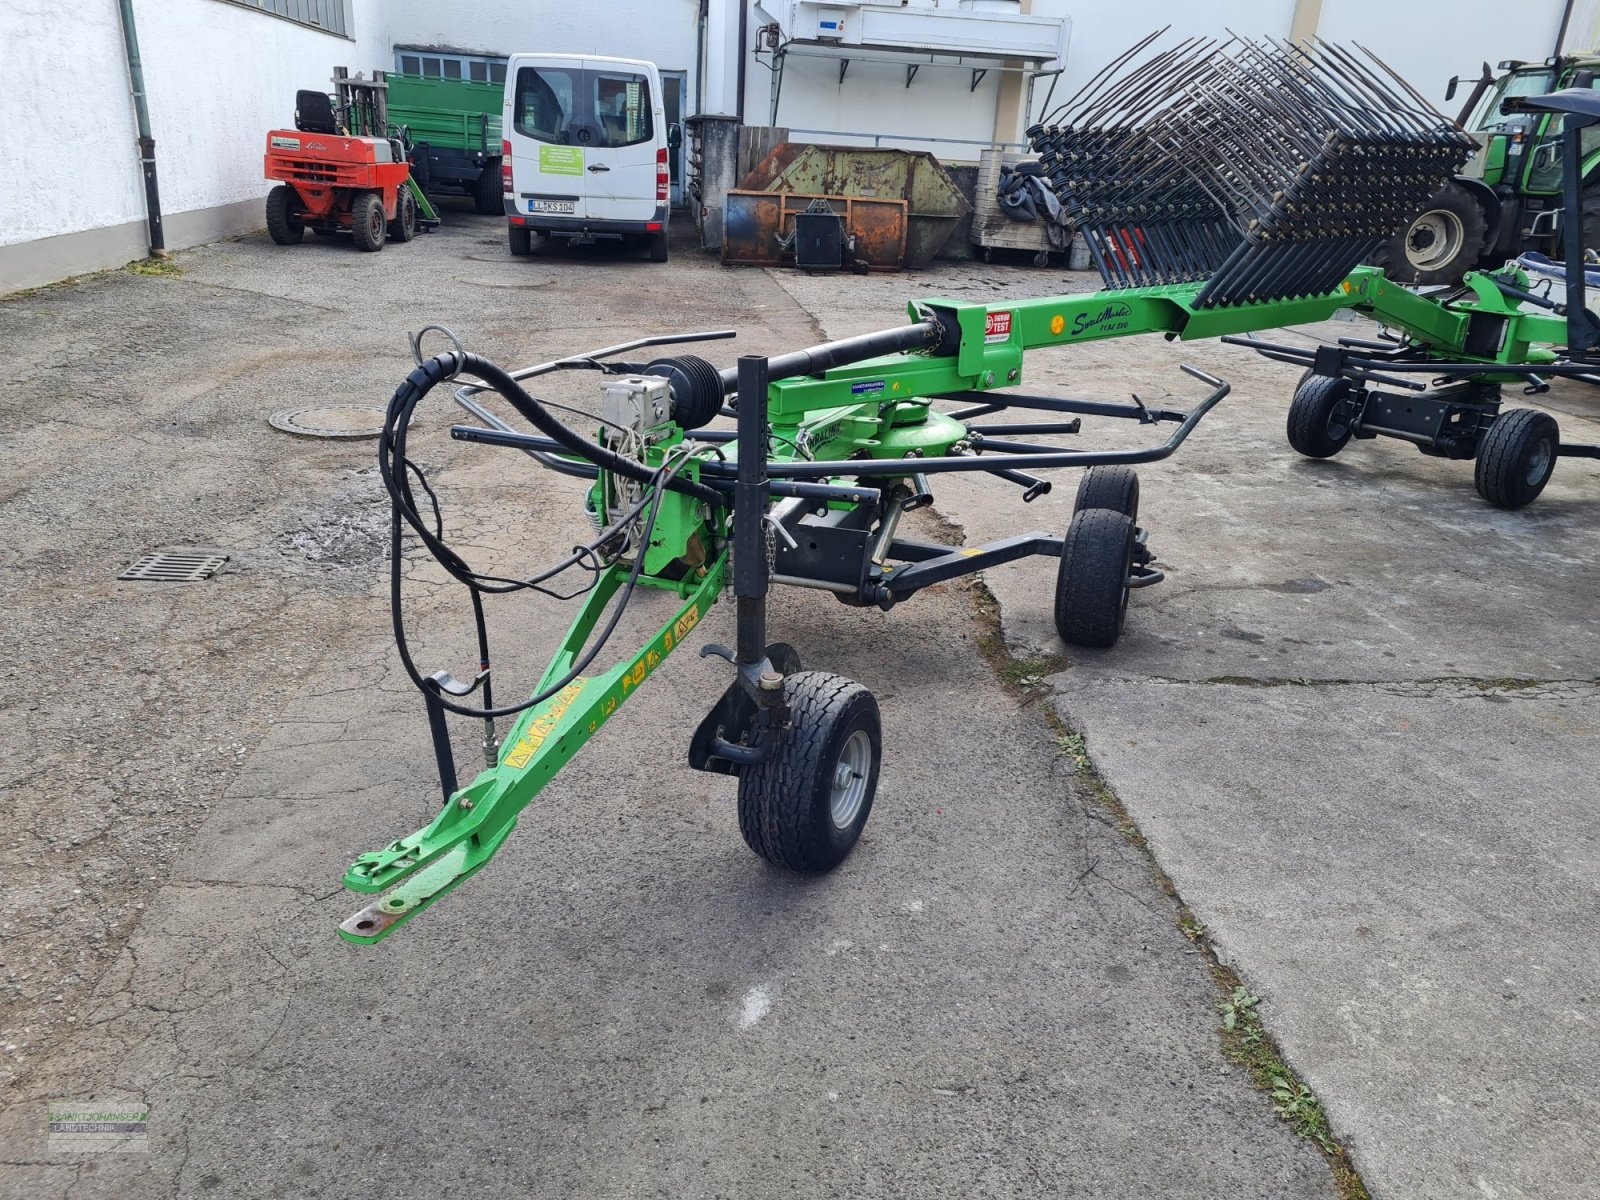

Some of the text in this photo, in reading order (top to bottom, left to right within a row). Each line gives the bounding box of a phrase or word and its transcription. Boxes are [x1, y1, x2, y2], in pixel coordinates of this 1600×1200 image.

[533, 201, 573, 211] LL KS 104
[993, 321, 1010, 333] TEST
